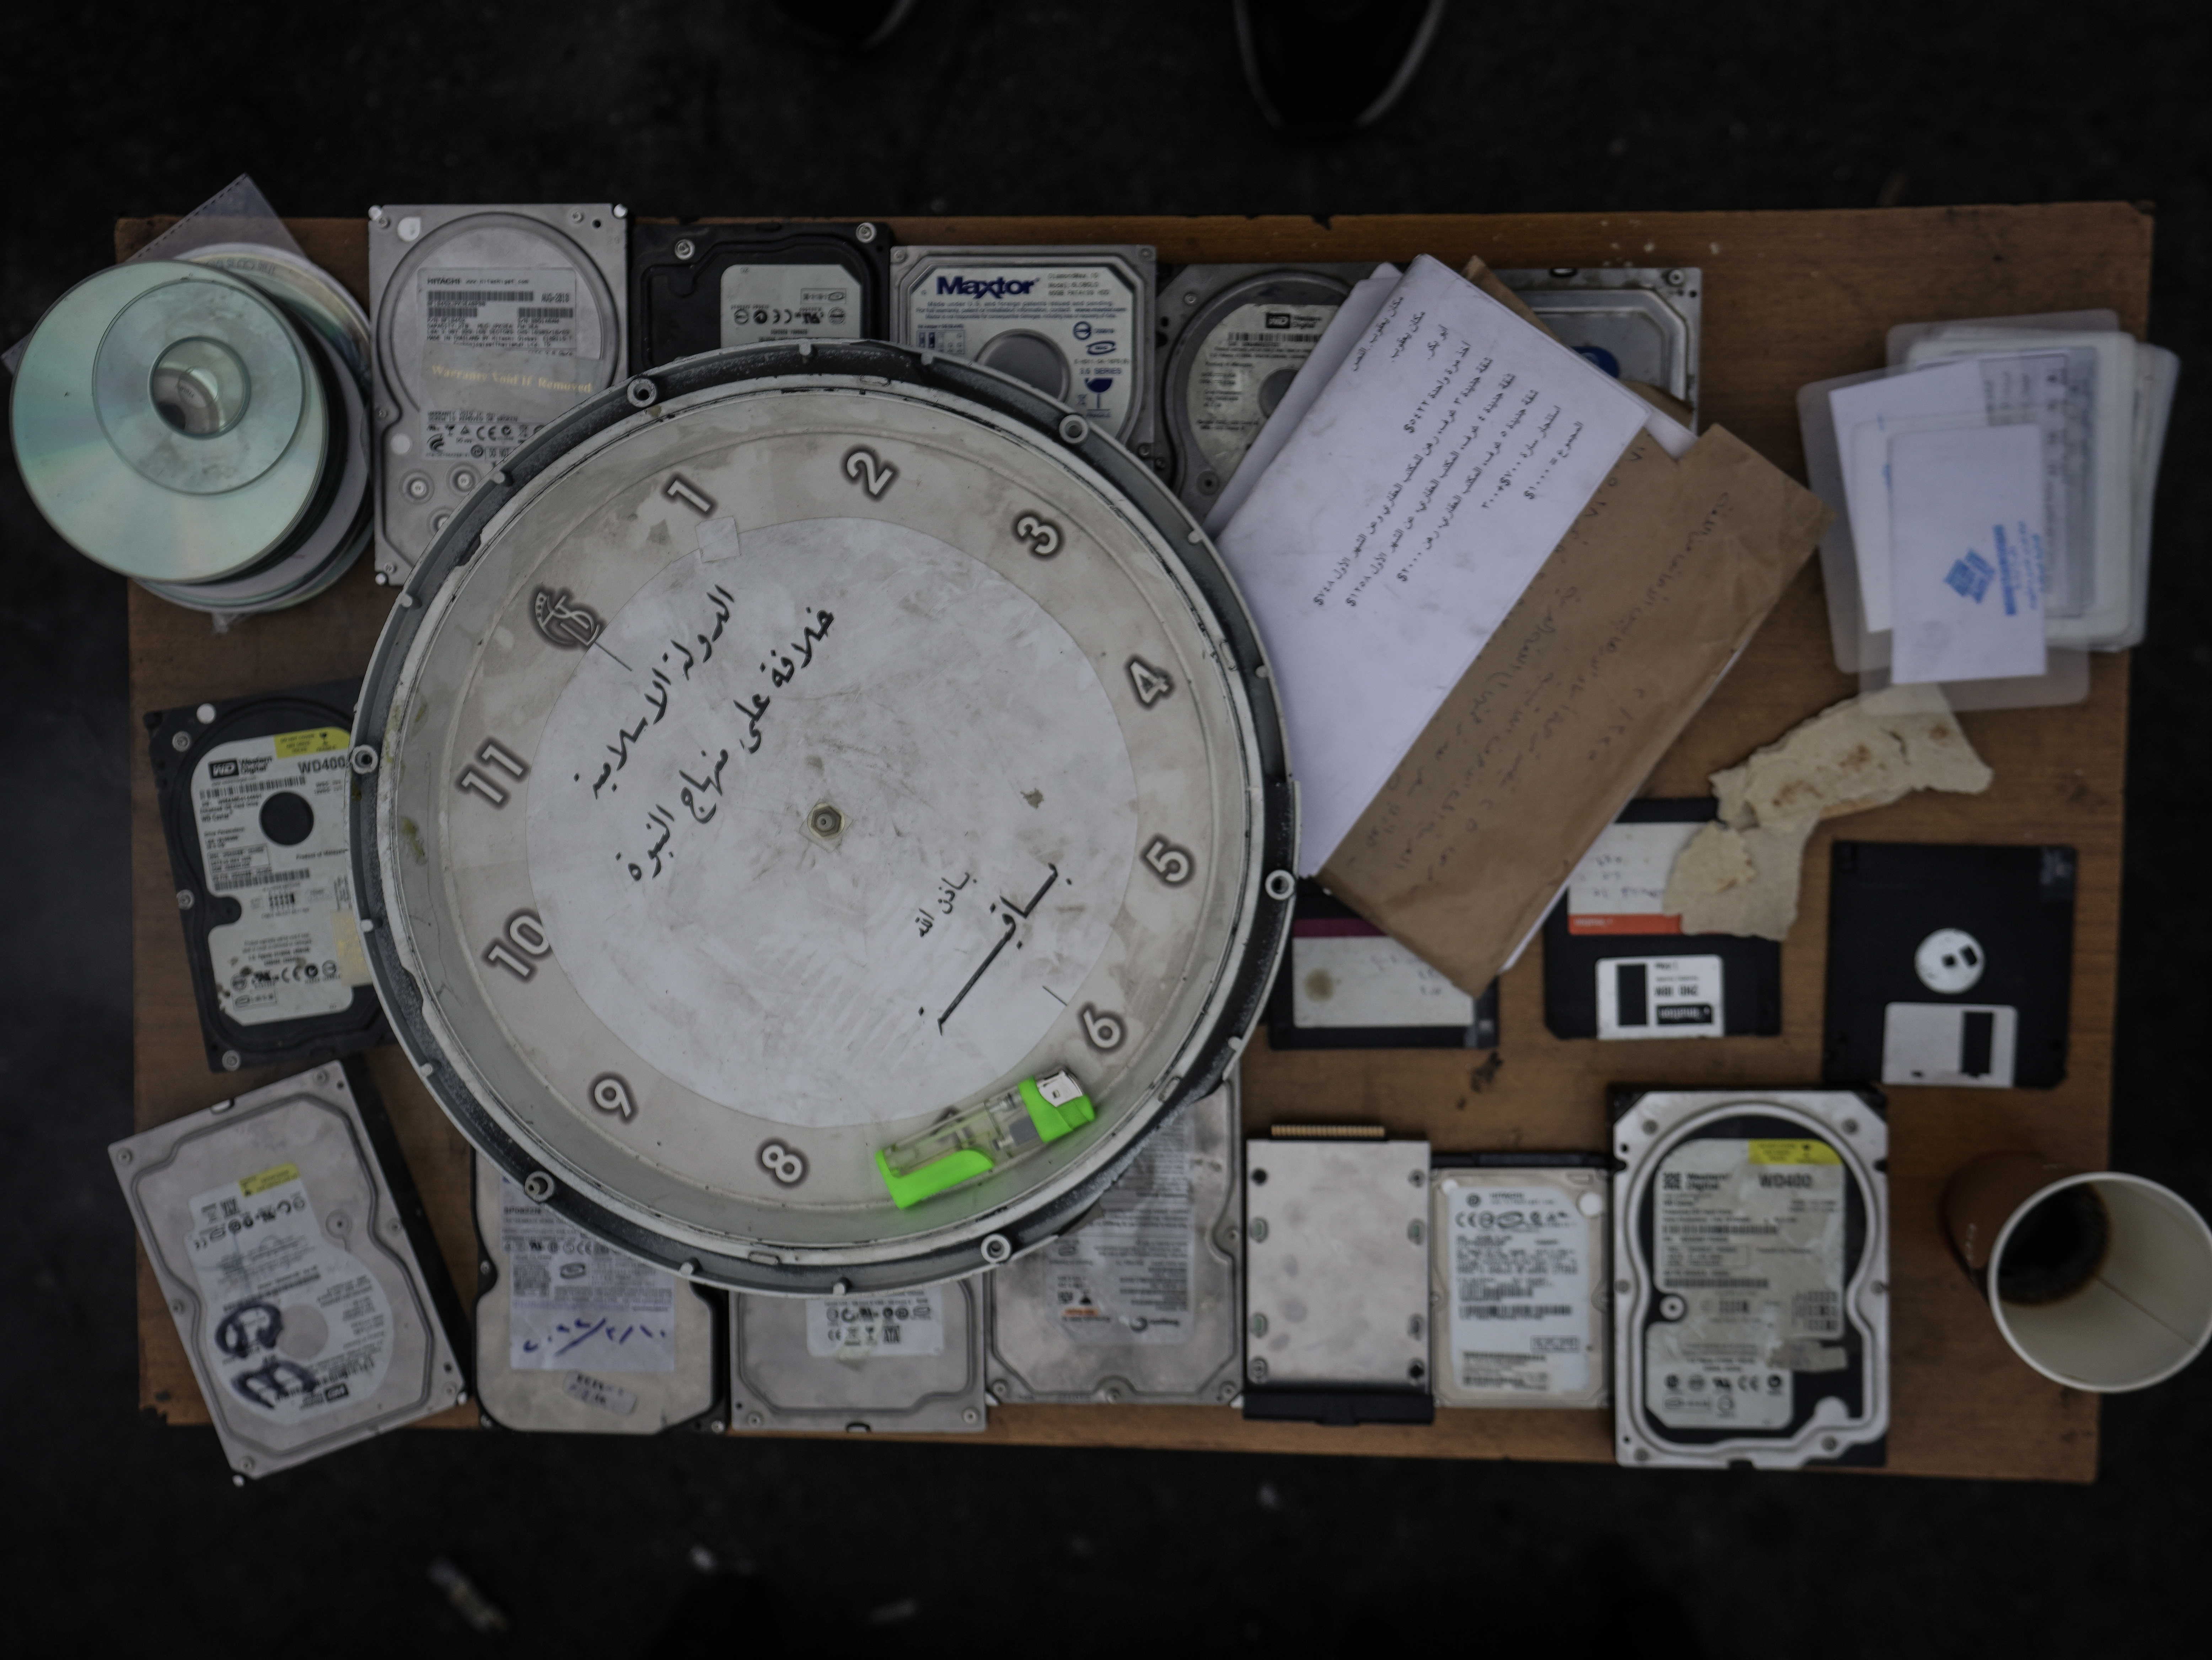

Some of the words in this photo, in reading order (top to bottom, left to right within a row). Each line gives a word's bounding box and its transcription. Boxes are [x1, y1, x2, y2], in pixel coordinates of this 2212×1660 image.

[936, 276, 1033, 299] Maxtor
[1389, 296, 1403, 317] مكان
[1409, 311, 1425, 332] مكان
[432, 365, 487, 382] Warranty
[492, 372, 518, 385] Void
[538, 377, 592, 394] Removed
[1445, 360, 1460, 374] مرة
[1428, 377, 1450, 398] واحدة
[1461, 376, 1481, 397] جديدة
[1483, 393, 1503, 413] جديدة
[1506, 409, 1526, 429] جديدة
[1557, 421, 1583, 458] المجموع
[844, 452, 896, 496] 2
[1440, 451, 1459, 478] المكتب
[1462, 466, 1482, 494] المكتب
[665, 476, 713, 514] 1
[1383, 483, 1403, 514] العقاري
[1017, 514, 1063, 556] 3
[1353, 533, 1366, 558] الشهر
[1390, 529, 1403, 552] الشهر
[1333, 557, 1350, 579] الأول
[1370, 552, 1387, 574] الأول
[662, 585, 734, 680] الدولة
[759, 607, 834, 688] خلافة
[1126, 661, 1171, 706] 4
[461, 739, 528, 809] 11
[678, 749, 729, 824] منهاج
[615, 804, 674, 881] النبوة
[1144, 840, 1193, 885] 5
[938, 872, 977, 914] باذن
[915, 908, 934, 937] الله
[488, 912, 550, 980] 10
[758, 1139, 803, 1185] 8
